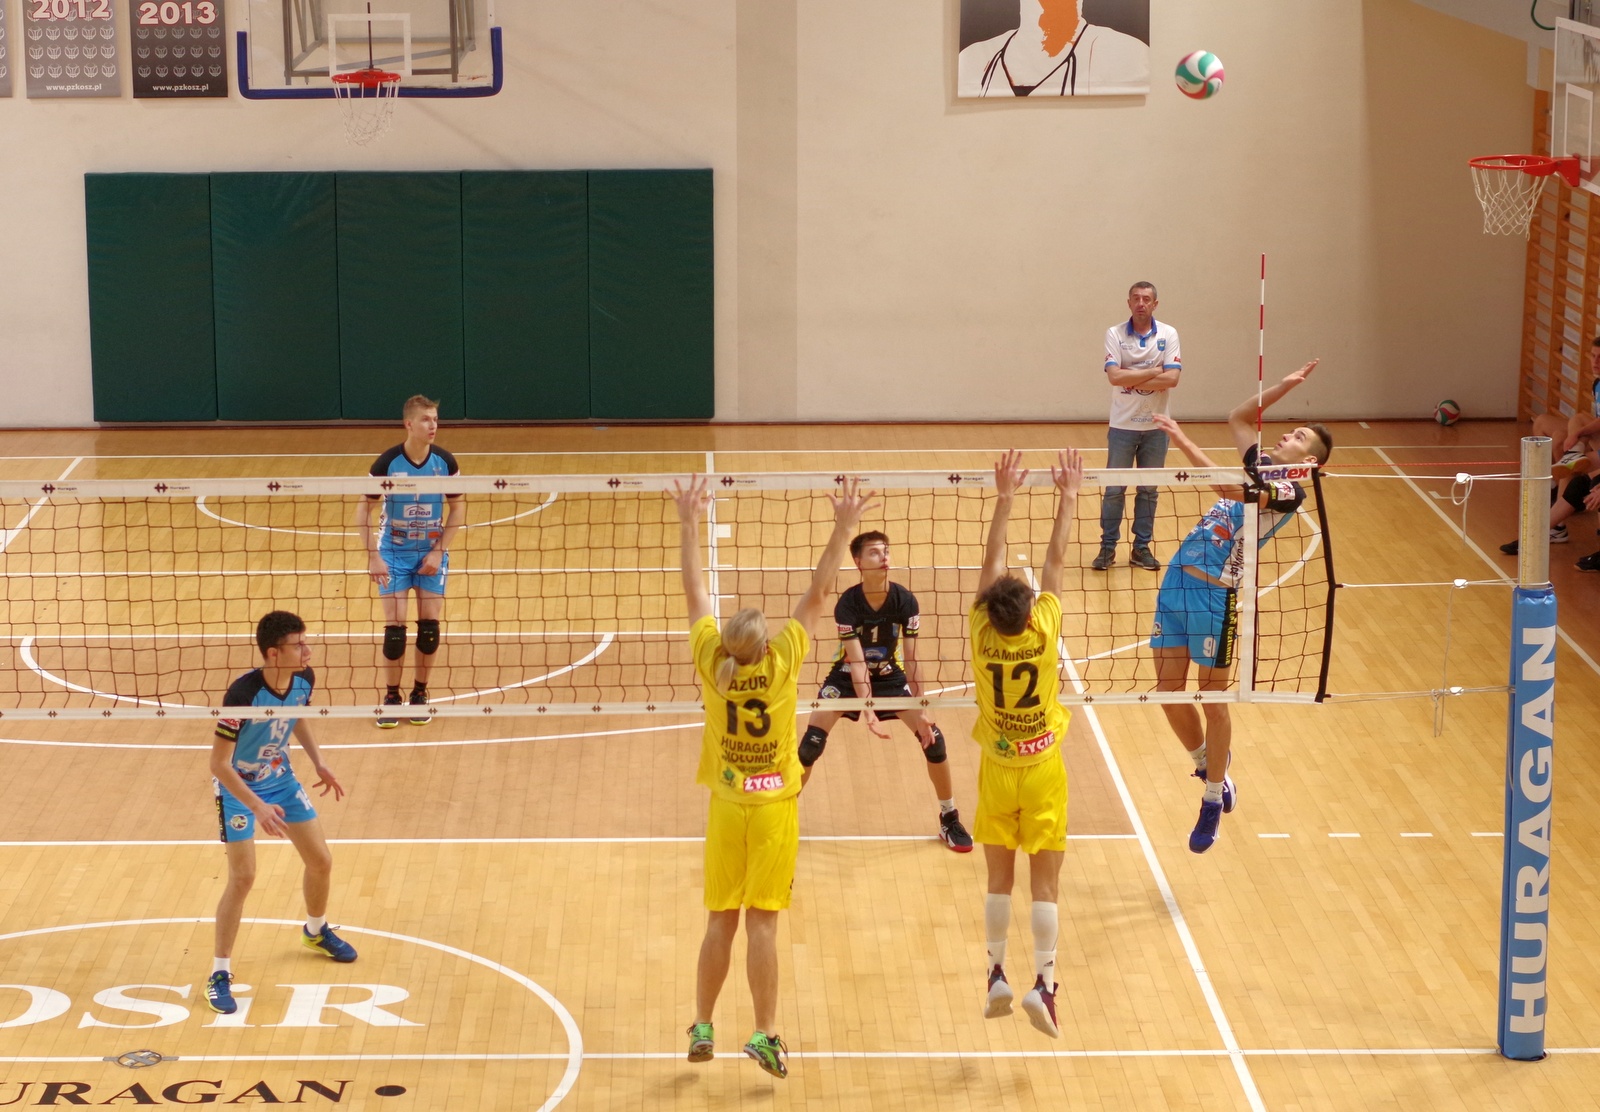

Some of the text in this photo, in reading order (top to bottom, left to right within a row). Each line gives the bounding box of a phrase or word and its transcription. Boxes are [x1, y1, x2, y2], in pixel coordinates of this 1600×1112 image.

[31, 0, 111, 19] 2012
[139, 1, 217, 25] 2013
[46, 83, 102, 92] www.pzkosz.pl
[152, 83, 209, 92] www.pzkosz.pl
[1260, 467, 1310, 480] netex
[870, 625, 879, 643] 1
[985, 662, 1041, 709] 12
[726, 698, 771, 738] 13
[721, 736, 778, 754] HURAGAN
[1509, 625, 1557, 1034] HURAGAN
